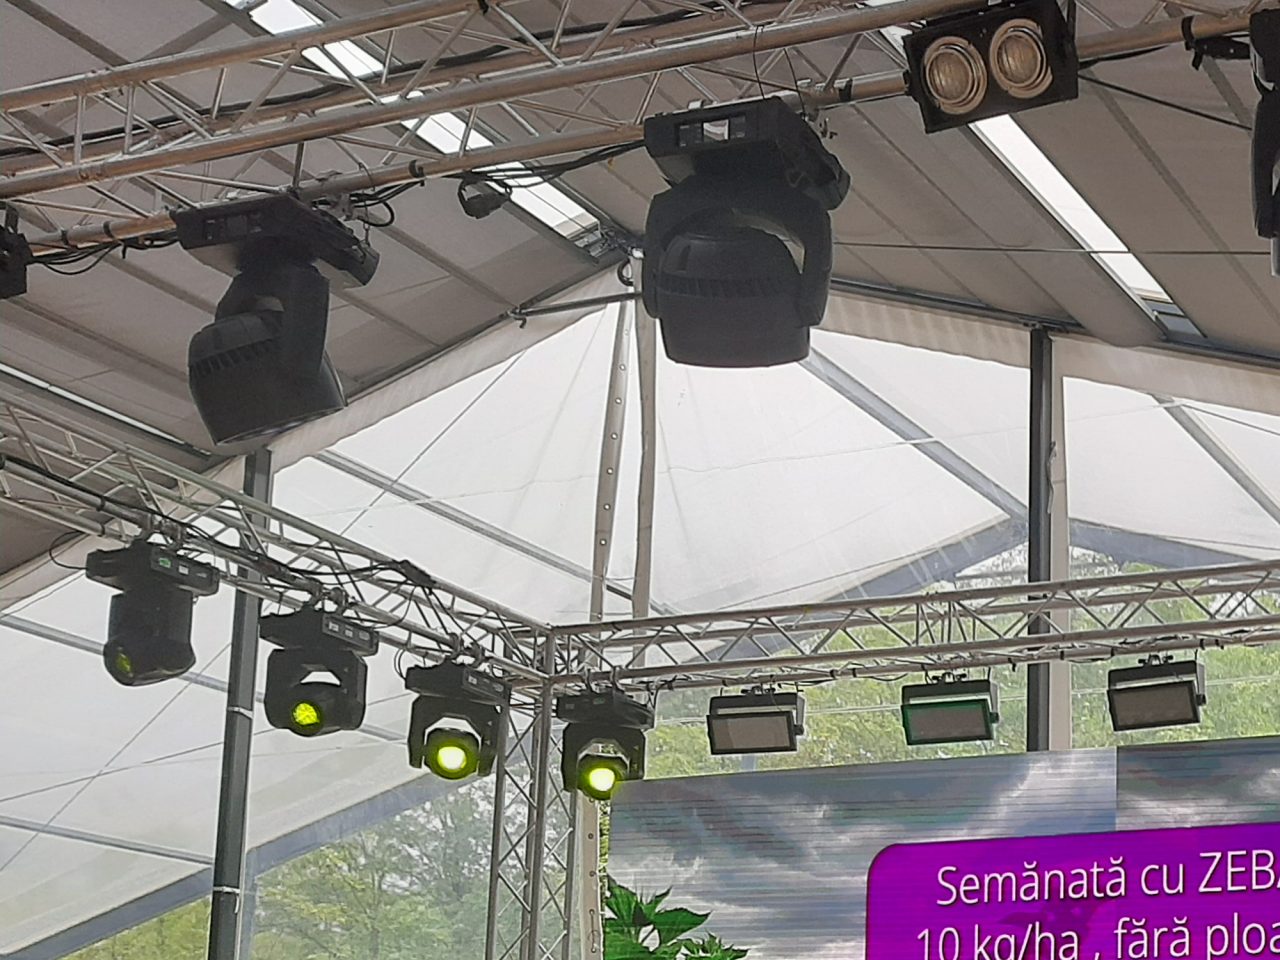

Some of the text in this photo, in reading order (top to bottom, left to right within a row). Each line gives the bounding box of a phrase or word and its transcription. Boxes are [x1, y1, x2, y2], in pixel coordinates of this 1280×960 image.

[937, 856, 1125, 905] Semănată
[1141, 863, 1184, 895] cu
[1114, 916, 1190, 959] fără
